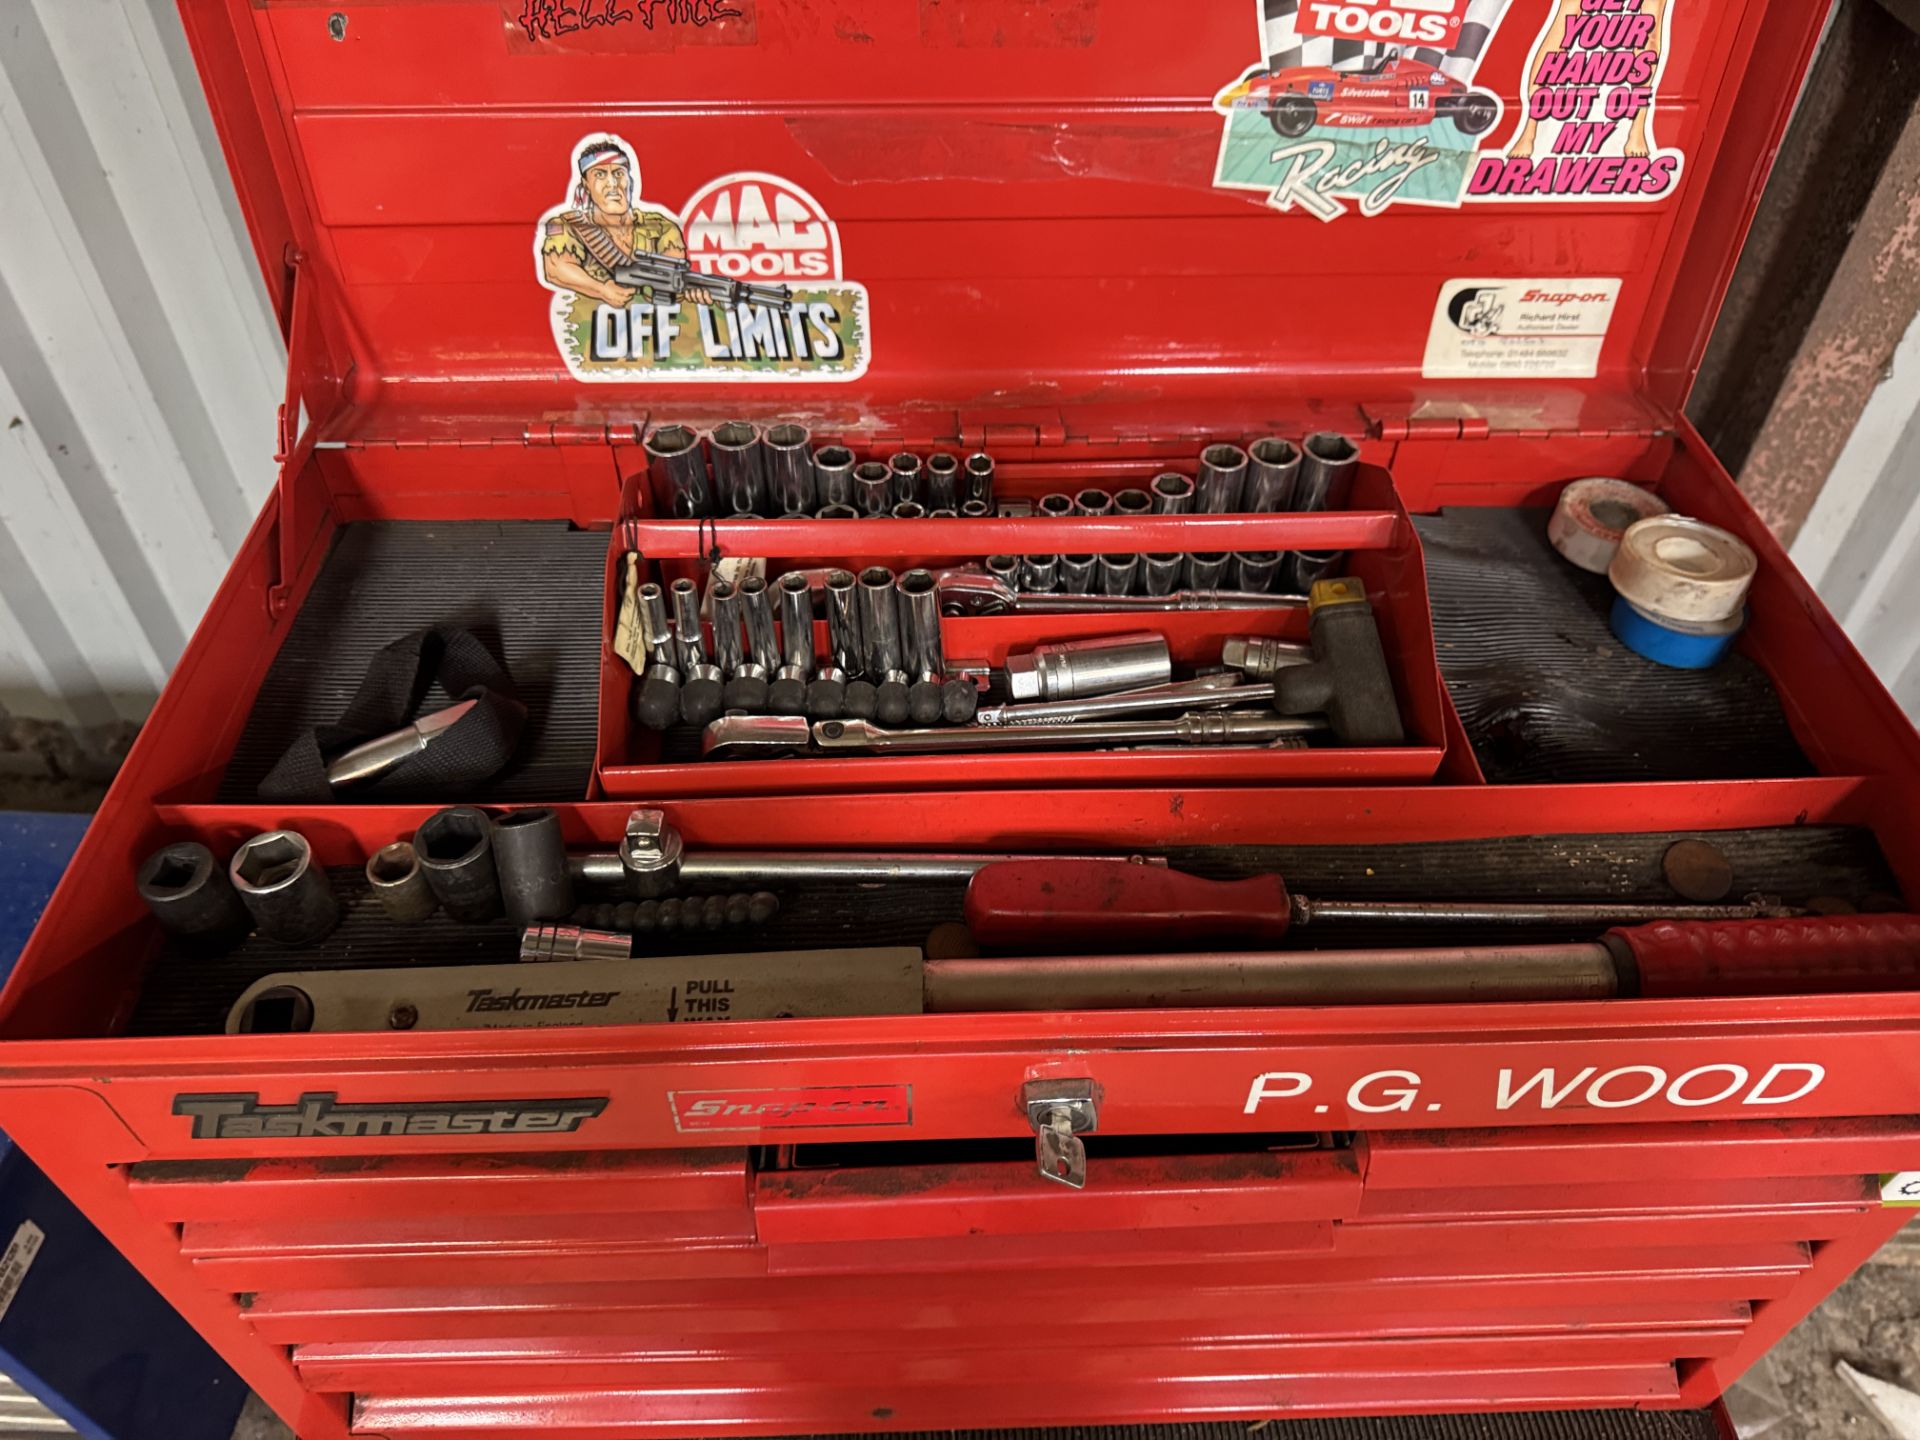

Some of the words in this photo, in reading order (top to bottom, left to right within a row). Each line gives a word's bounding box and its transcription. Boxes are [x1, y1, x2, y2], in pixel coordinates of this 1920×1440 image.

[1559, 14, 1656, 50] YOUR
[1534, 51, 1659, 86] HANDS
[1340, 87, 1390, 98] Silverstone
[1412, 91, 1426, 107] 14
[1528, 86, 1600, 121] OUT
[1604, 86, 1653, 121] OF
[1551, 121, 1618, 155] MY
[1270, 136, 1440, 216] Racing
[1466, 155, 1678, 195] DRAWERS
[688, 184, 828, 250] MAC
[690, 251, 829, 277] TOOLS
[591, 303, 681, 362] OFF
[697, 302, 843, 362] LIMITS
[466, 988, 620, 1013] Taskmaster
[685, 997, 730, 1012] THIS
[686, 980, 735, 995] PULL
[1244, 1069, 1441, 1114] P.G.
[1496, 1063, 1826, 1110] WOOD
[174, 1095, 604, 1138] Taskmaster
